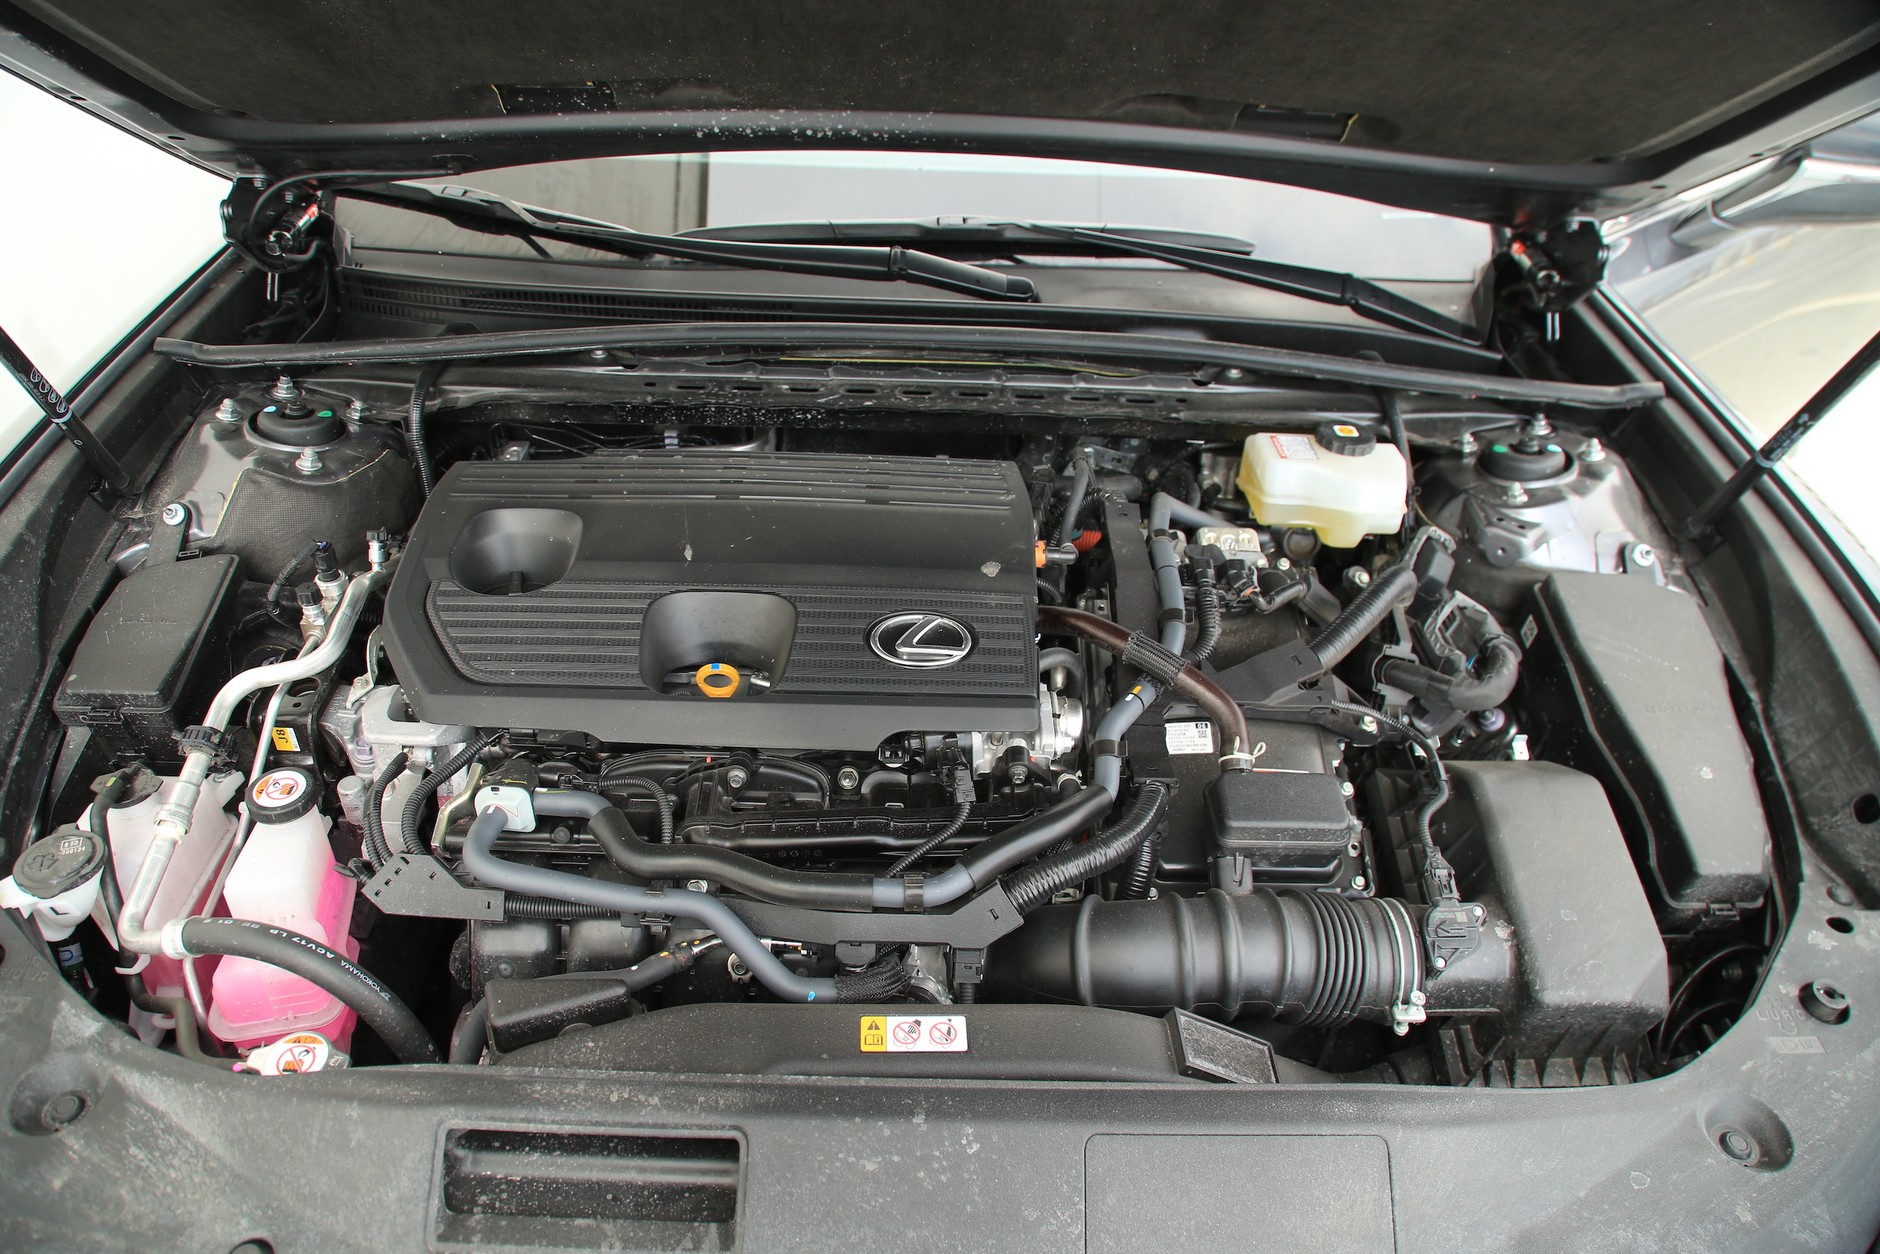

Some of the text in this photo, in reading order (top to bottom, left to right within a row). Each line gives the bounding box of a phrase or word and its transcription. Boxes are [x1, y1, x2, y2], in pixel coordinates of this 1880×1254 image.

[269, 928, 287, 938] LP
[292, 937, 335, 959] ACV17
[341, 960, 381, 992] YOKOHAMA
